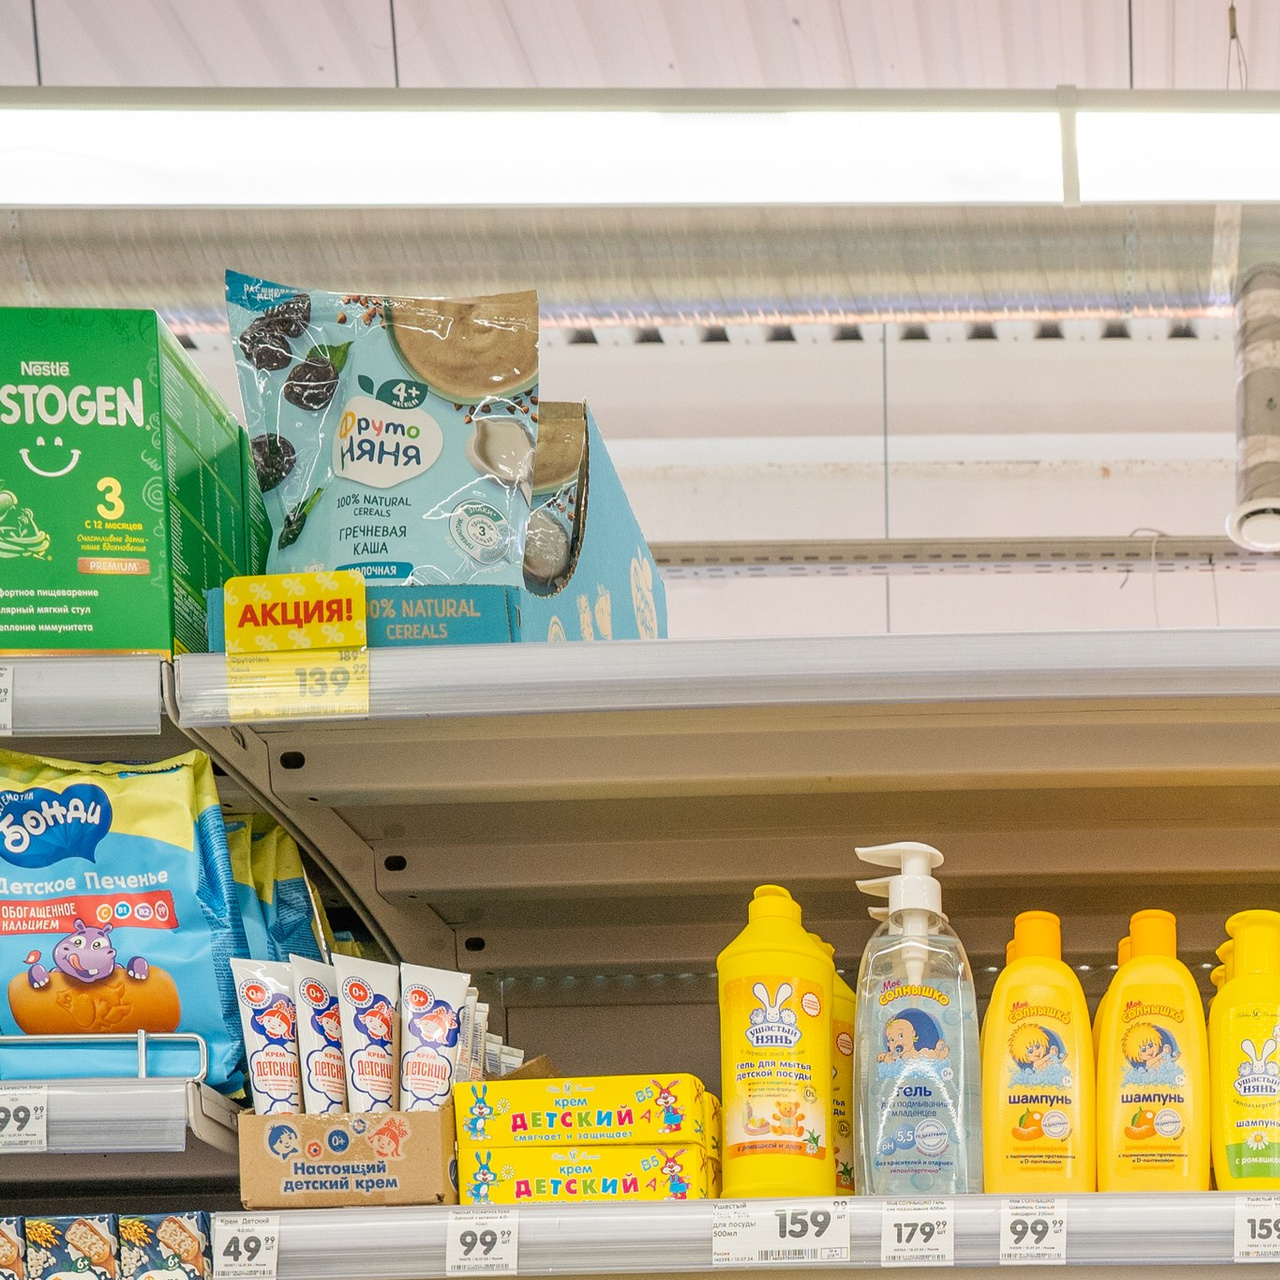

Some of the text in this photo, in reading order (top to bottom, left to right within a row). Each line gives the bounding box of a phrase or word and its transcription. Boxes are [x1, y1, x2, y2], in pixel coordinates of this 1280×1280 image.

[392, 383, 420, 402] 4+
[97, 477, 124, 520] 3
[338, 495, 411, 508] 100% NATURAL
[354, 508, 391, 518] CEREALS
[93, 521, 102, 529] 12
[105, 522, 142, 530] месяцев
[339, 526, 407, 541] ГРЕЧНЕВАЯ
[353, 542, 388, 556] КАША
[90, 561, 137, 572] PREMIUM
[37, 606, 68, 614] мягкий
[238, 599, 353, 628] АКЦИЯ!
[294, 667, 350, 697] 139
[84, 871, 168, 889] Печенье
[2, 903, 76, 918] ОБОГАЩЕННОЕ
[2, 919, 59, 931] КАЛЬЦИЕМ
[780, 1062, 811, 1070] мытья
[736, 1070, 811, 1081] детской посуды
[554, 1098, 587, 1109] крем
[511, 1105, 634, 1132] ДЕТСКИЙ
[1237, 1120, 1280, 1128] шампунь
[513, 1133, 561, 1142] смягчает
[577, 1131, 633, 1140] защищает
[294, 1161, 386, 1176] Настоящий
[284, 1177, 398, 1192] детский крем
[775, 1209, 831, 1238] 159
[894, 1221, 947, 1243] 179 99
[223, 1237, 275, 1261] 49 99
